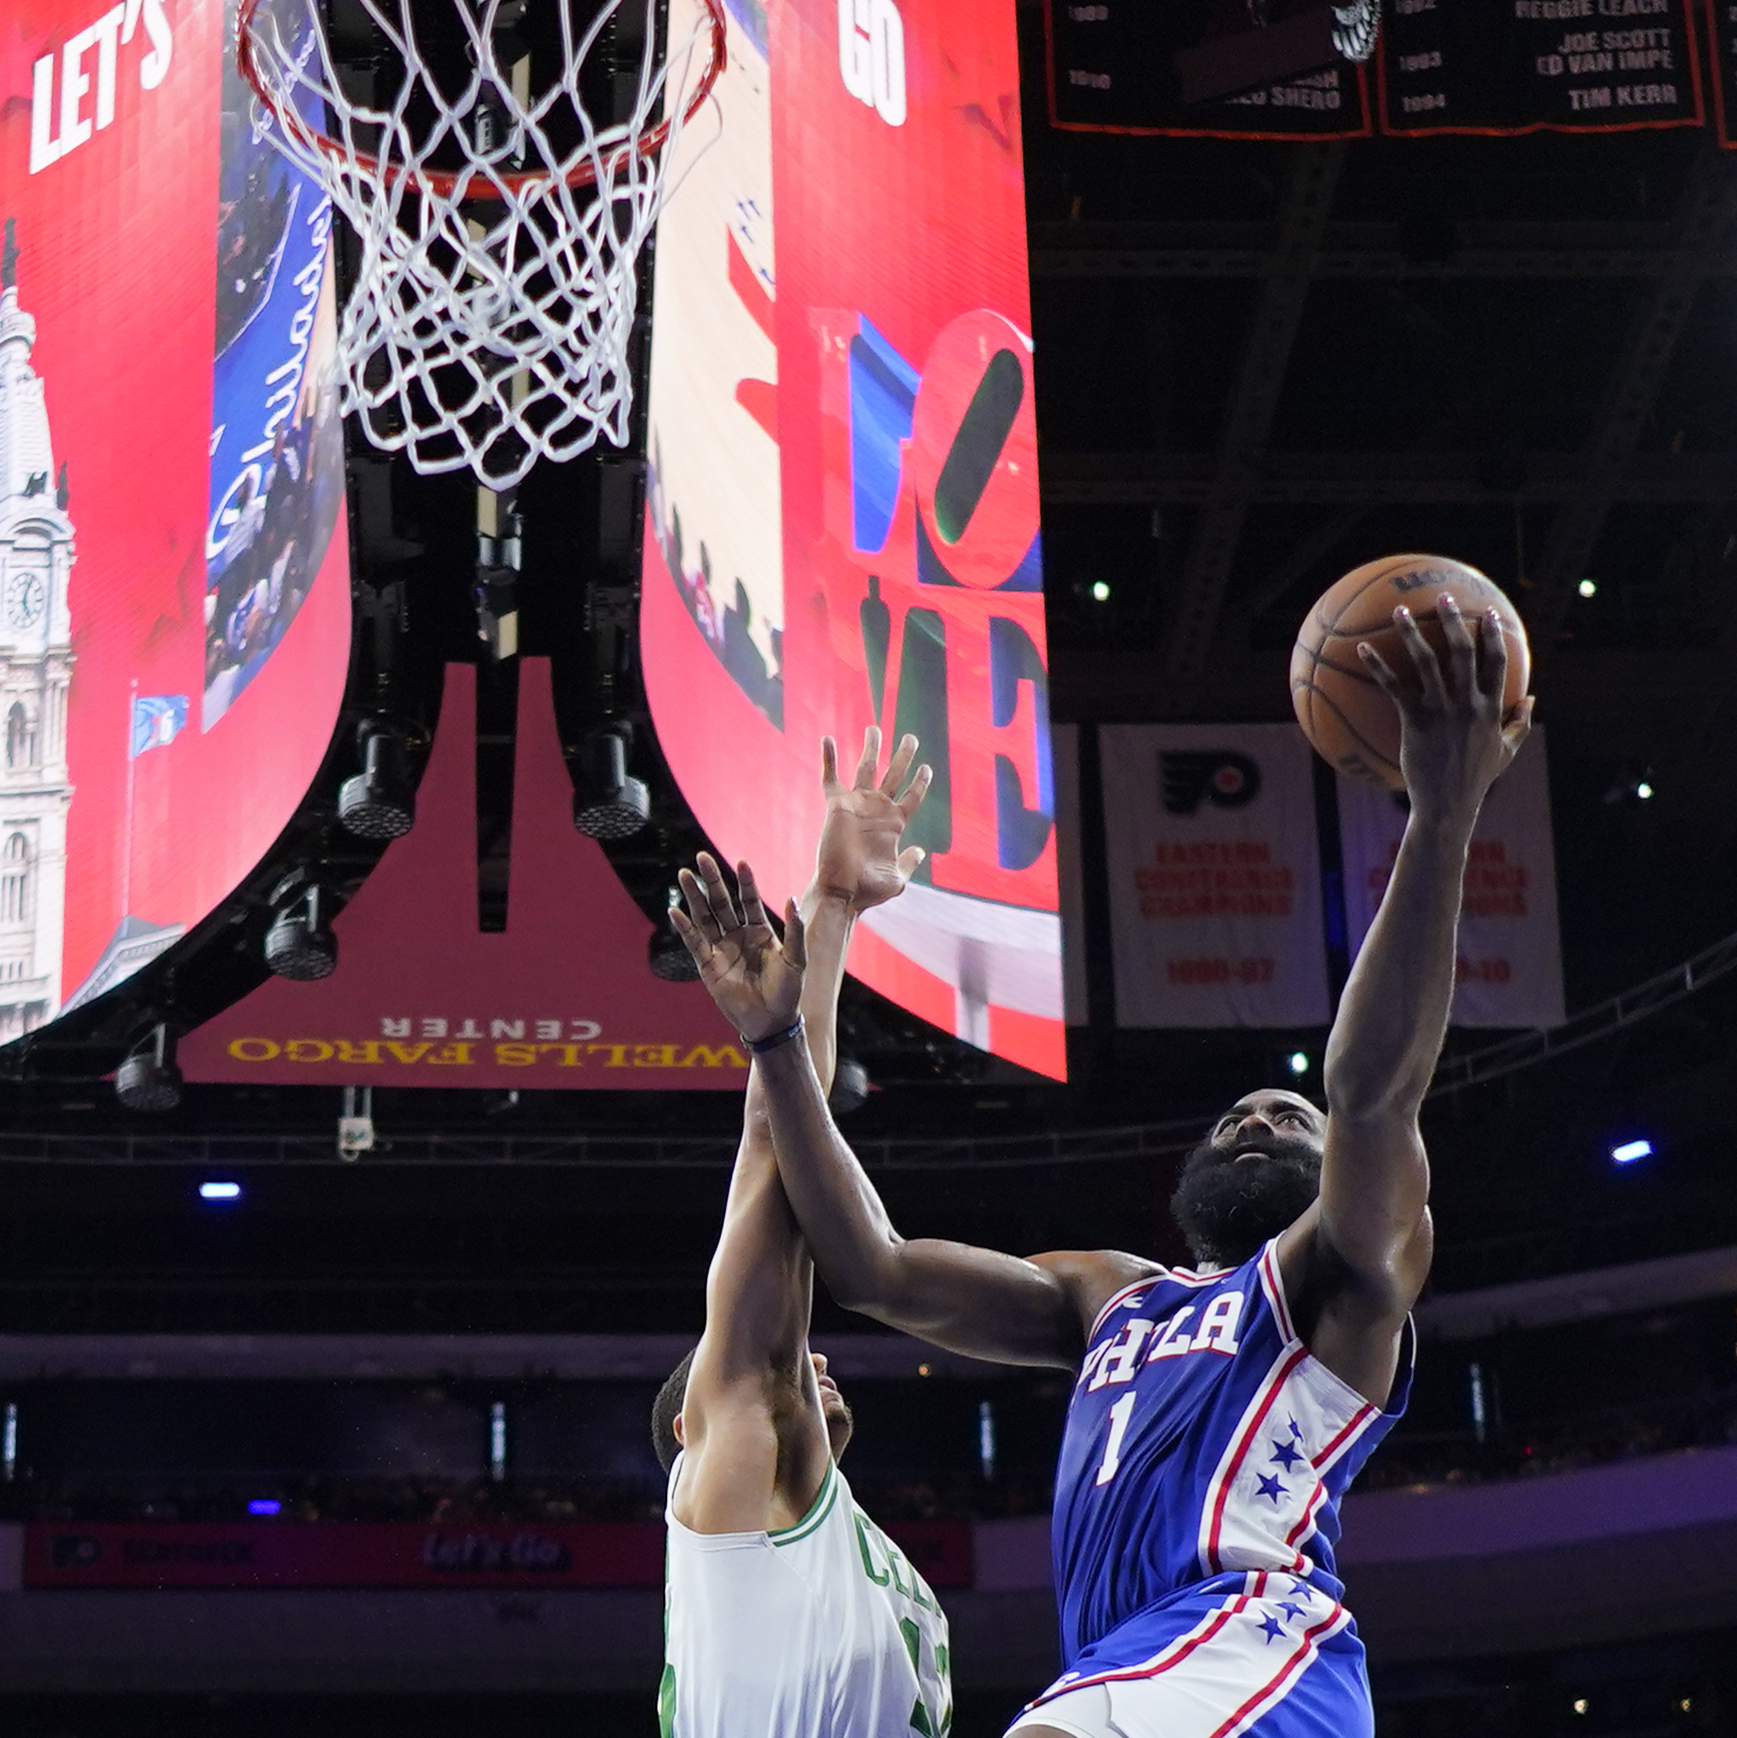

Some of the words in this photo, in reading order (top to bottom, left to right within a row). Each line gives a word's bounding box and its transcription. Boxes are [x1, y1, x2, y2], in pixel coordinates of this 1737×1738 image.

[1559, 31, 1600, 53] JOE
[1602, 28, 1671, 49] SCOTT
[838, 0, 907, 127] GO
[1567, 51, 1613, 74] VAN
[29, 0, 173, 175] LET'S
[1568, 86, 1612, 110] TIM
[1616, 84, 1677, 107] KERR
[382, 1016, 603, 1041] CENTER
[226, 1036, 476, 1067] FARGO
[496, 1041, 751, 1068] WELLS
[1095, 1390, 1138, 1487] 1
[854, 1510, 942, 1620] CEL
